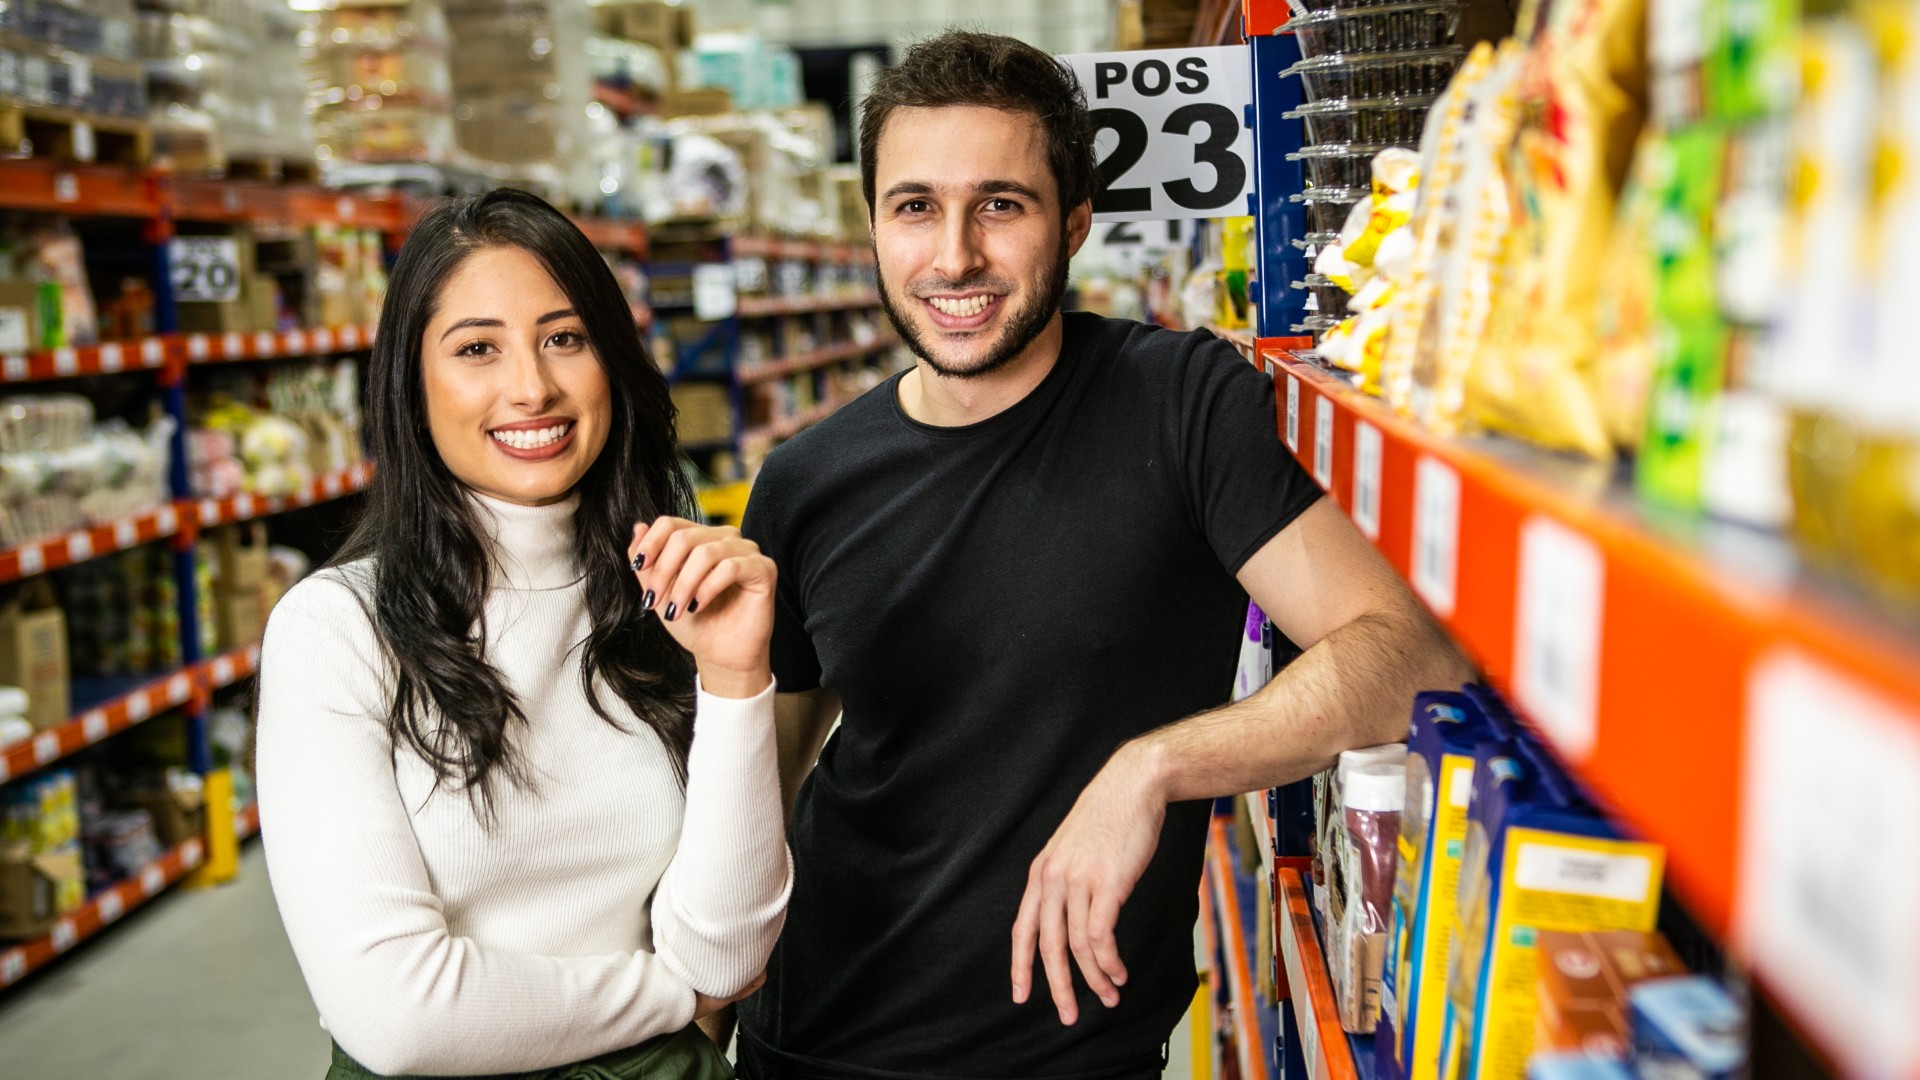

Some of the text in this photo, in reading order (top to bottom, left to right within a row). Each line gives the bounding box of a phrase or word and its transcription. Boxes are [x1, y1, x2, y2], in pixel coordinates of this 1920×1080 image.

[1095, 57, 1209, 99] POS
[1088, 102, 1246, 213] 23
[175, 258, 235, 298] 20
